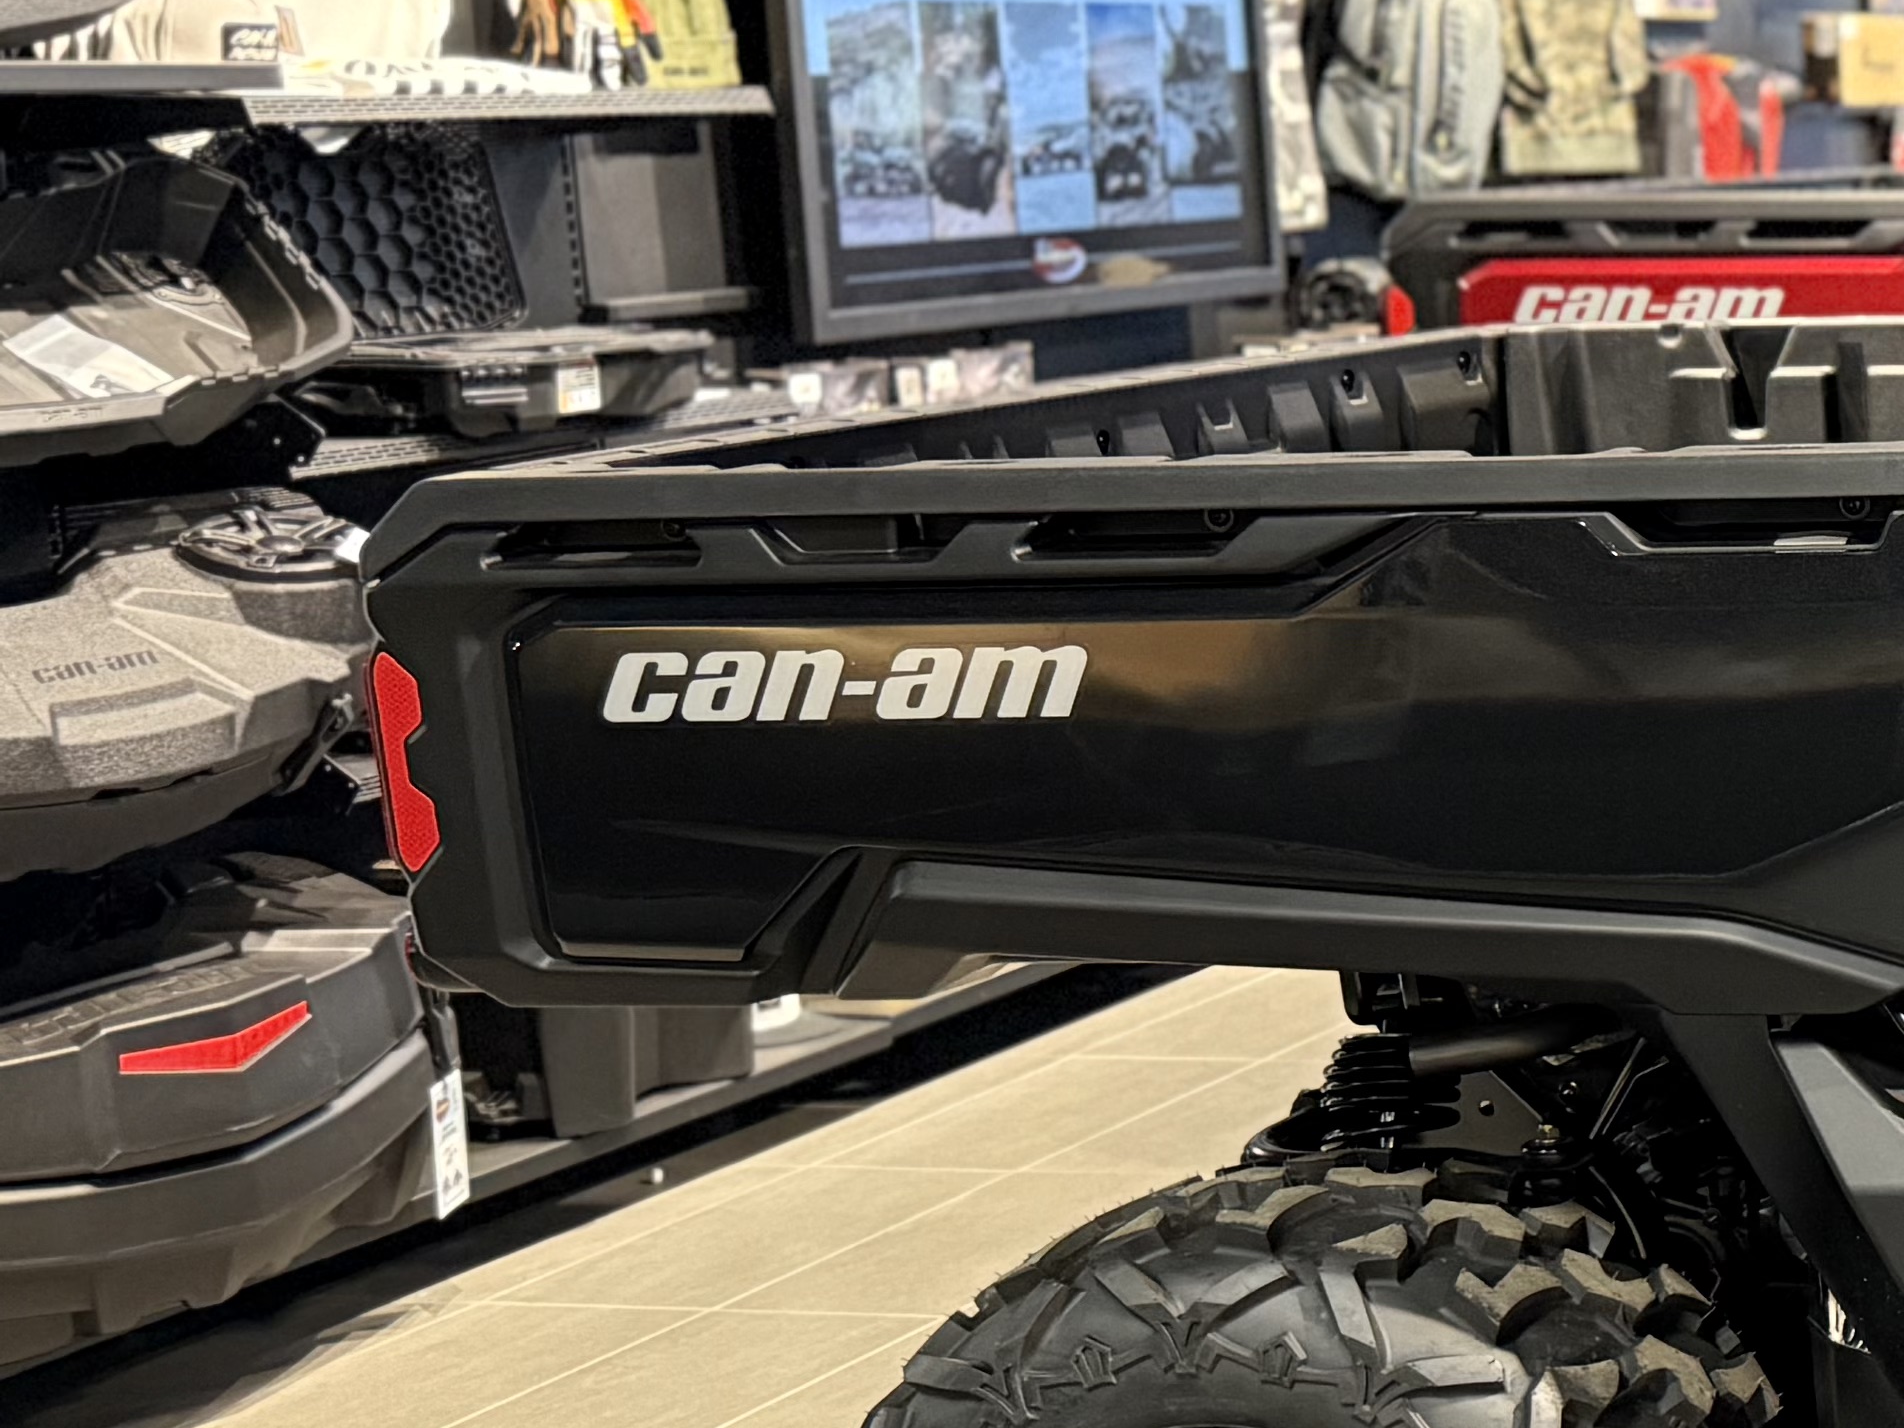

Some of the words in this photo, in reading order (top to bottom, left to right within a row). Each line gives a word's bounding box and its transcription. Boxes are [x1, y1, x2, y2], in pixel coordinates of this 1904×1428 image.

[1515, 286, 1784, 323] can-am
[32, 650, 159, 684] can-am
[602, 644, 1088, 722] can-am
